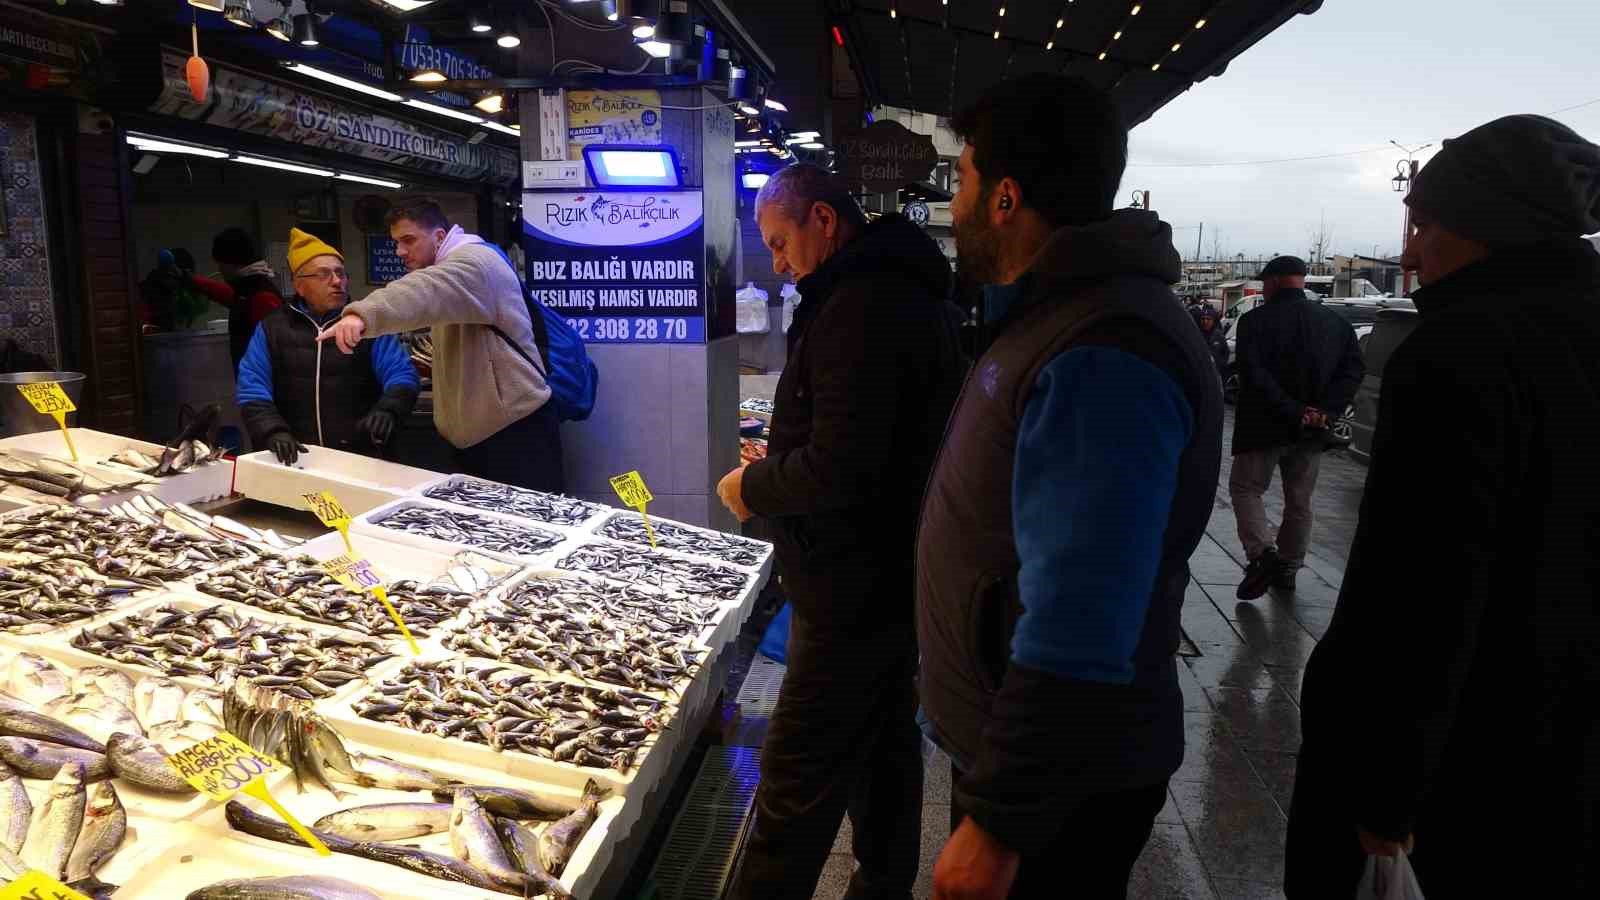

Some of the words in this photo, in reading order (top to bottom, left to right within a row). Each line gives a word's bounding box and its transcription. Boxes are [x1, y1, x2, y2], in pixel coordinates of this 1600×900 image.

[299, 95, 330, 133] ÖZ
[545, 203, 588, 227] RIZIK
[608, 196, 680, 225] BALIKÇILIK
[533, 261, 567, 280] BUZ
[571, 256, 627, 280] BALIĞI
[631, 260, 694, 280] VARDIR
[532, 289, 596, 311] KESİLMİŞ
[599, 289, 644, 308] HAMSİ
[648, 289, 698, 308] VARDIR
[595, 318, 629, 340] 308
[635, 318, 658, 340] 28
[663, 318, 687, 340] 70
[180, 742, 245, 777] ALABALIK
